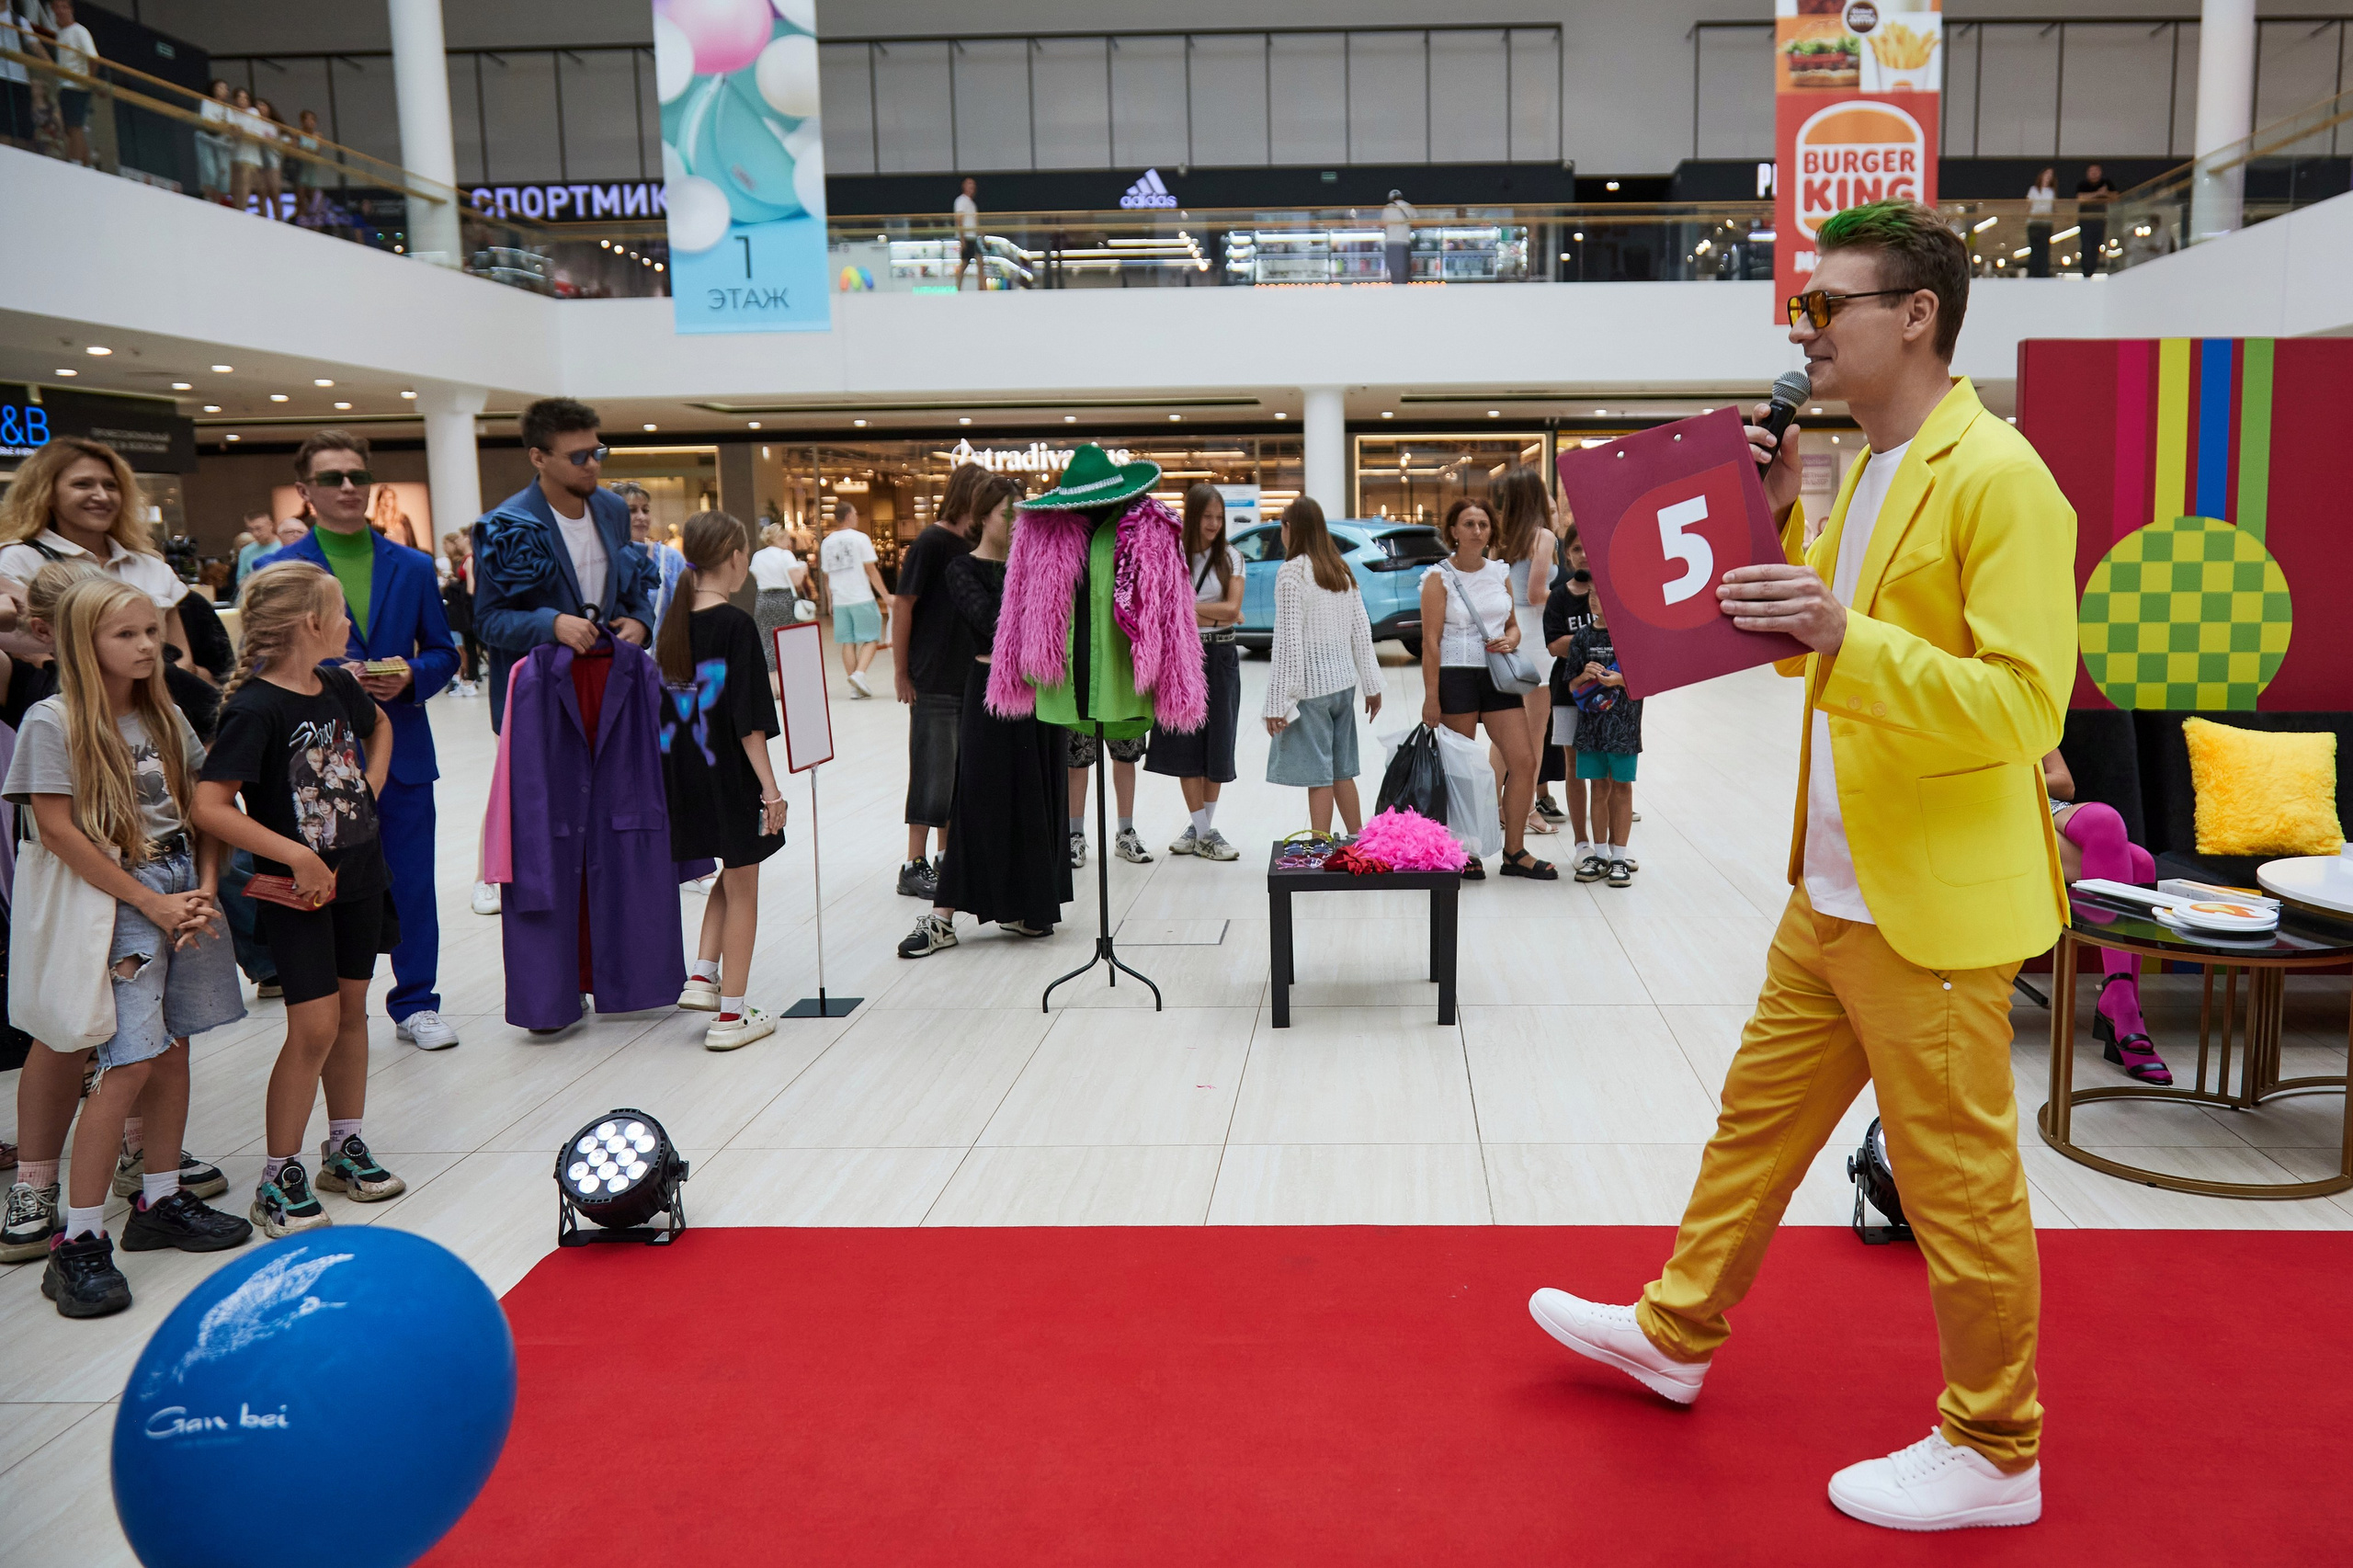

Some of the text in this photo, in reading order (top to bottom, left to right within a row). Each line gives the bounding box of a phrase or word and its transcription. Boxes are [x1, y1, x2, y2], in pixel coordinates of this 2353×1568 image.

[1803, 150, 1916, 174] BURGER
[1119, 192, 1178, 210] adidas
[1803, 176, 1915, 212] KING
[733, 234, 752, 279] 1
[707, 287, 790, 311] ЭТАЖ
[1656, 494, 1714, 607] 5
[144, 1402, 290, 1439] Gan bei
